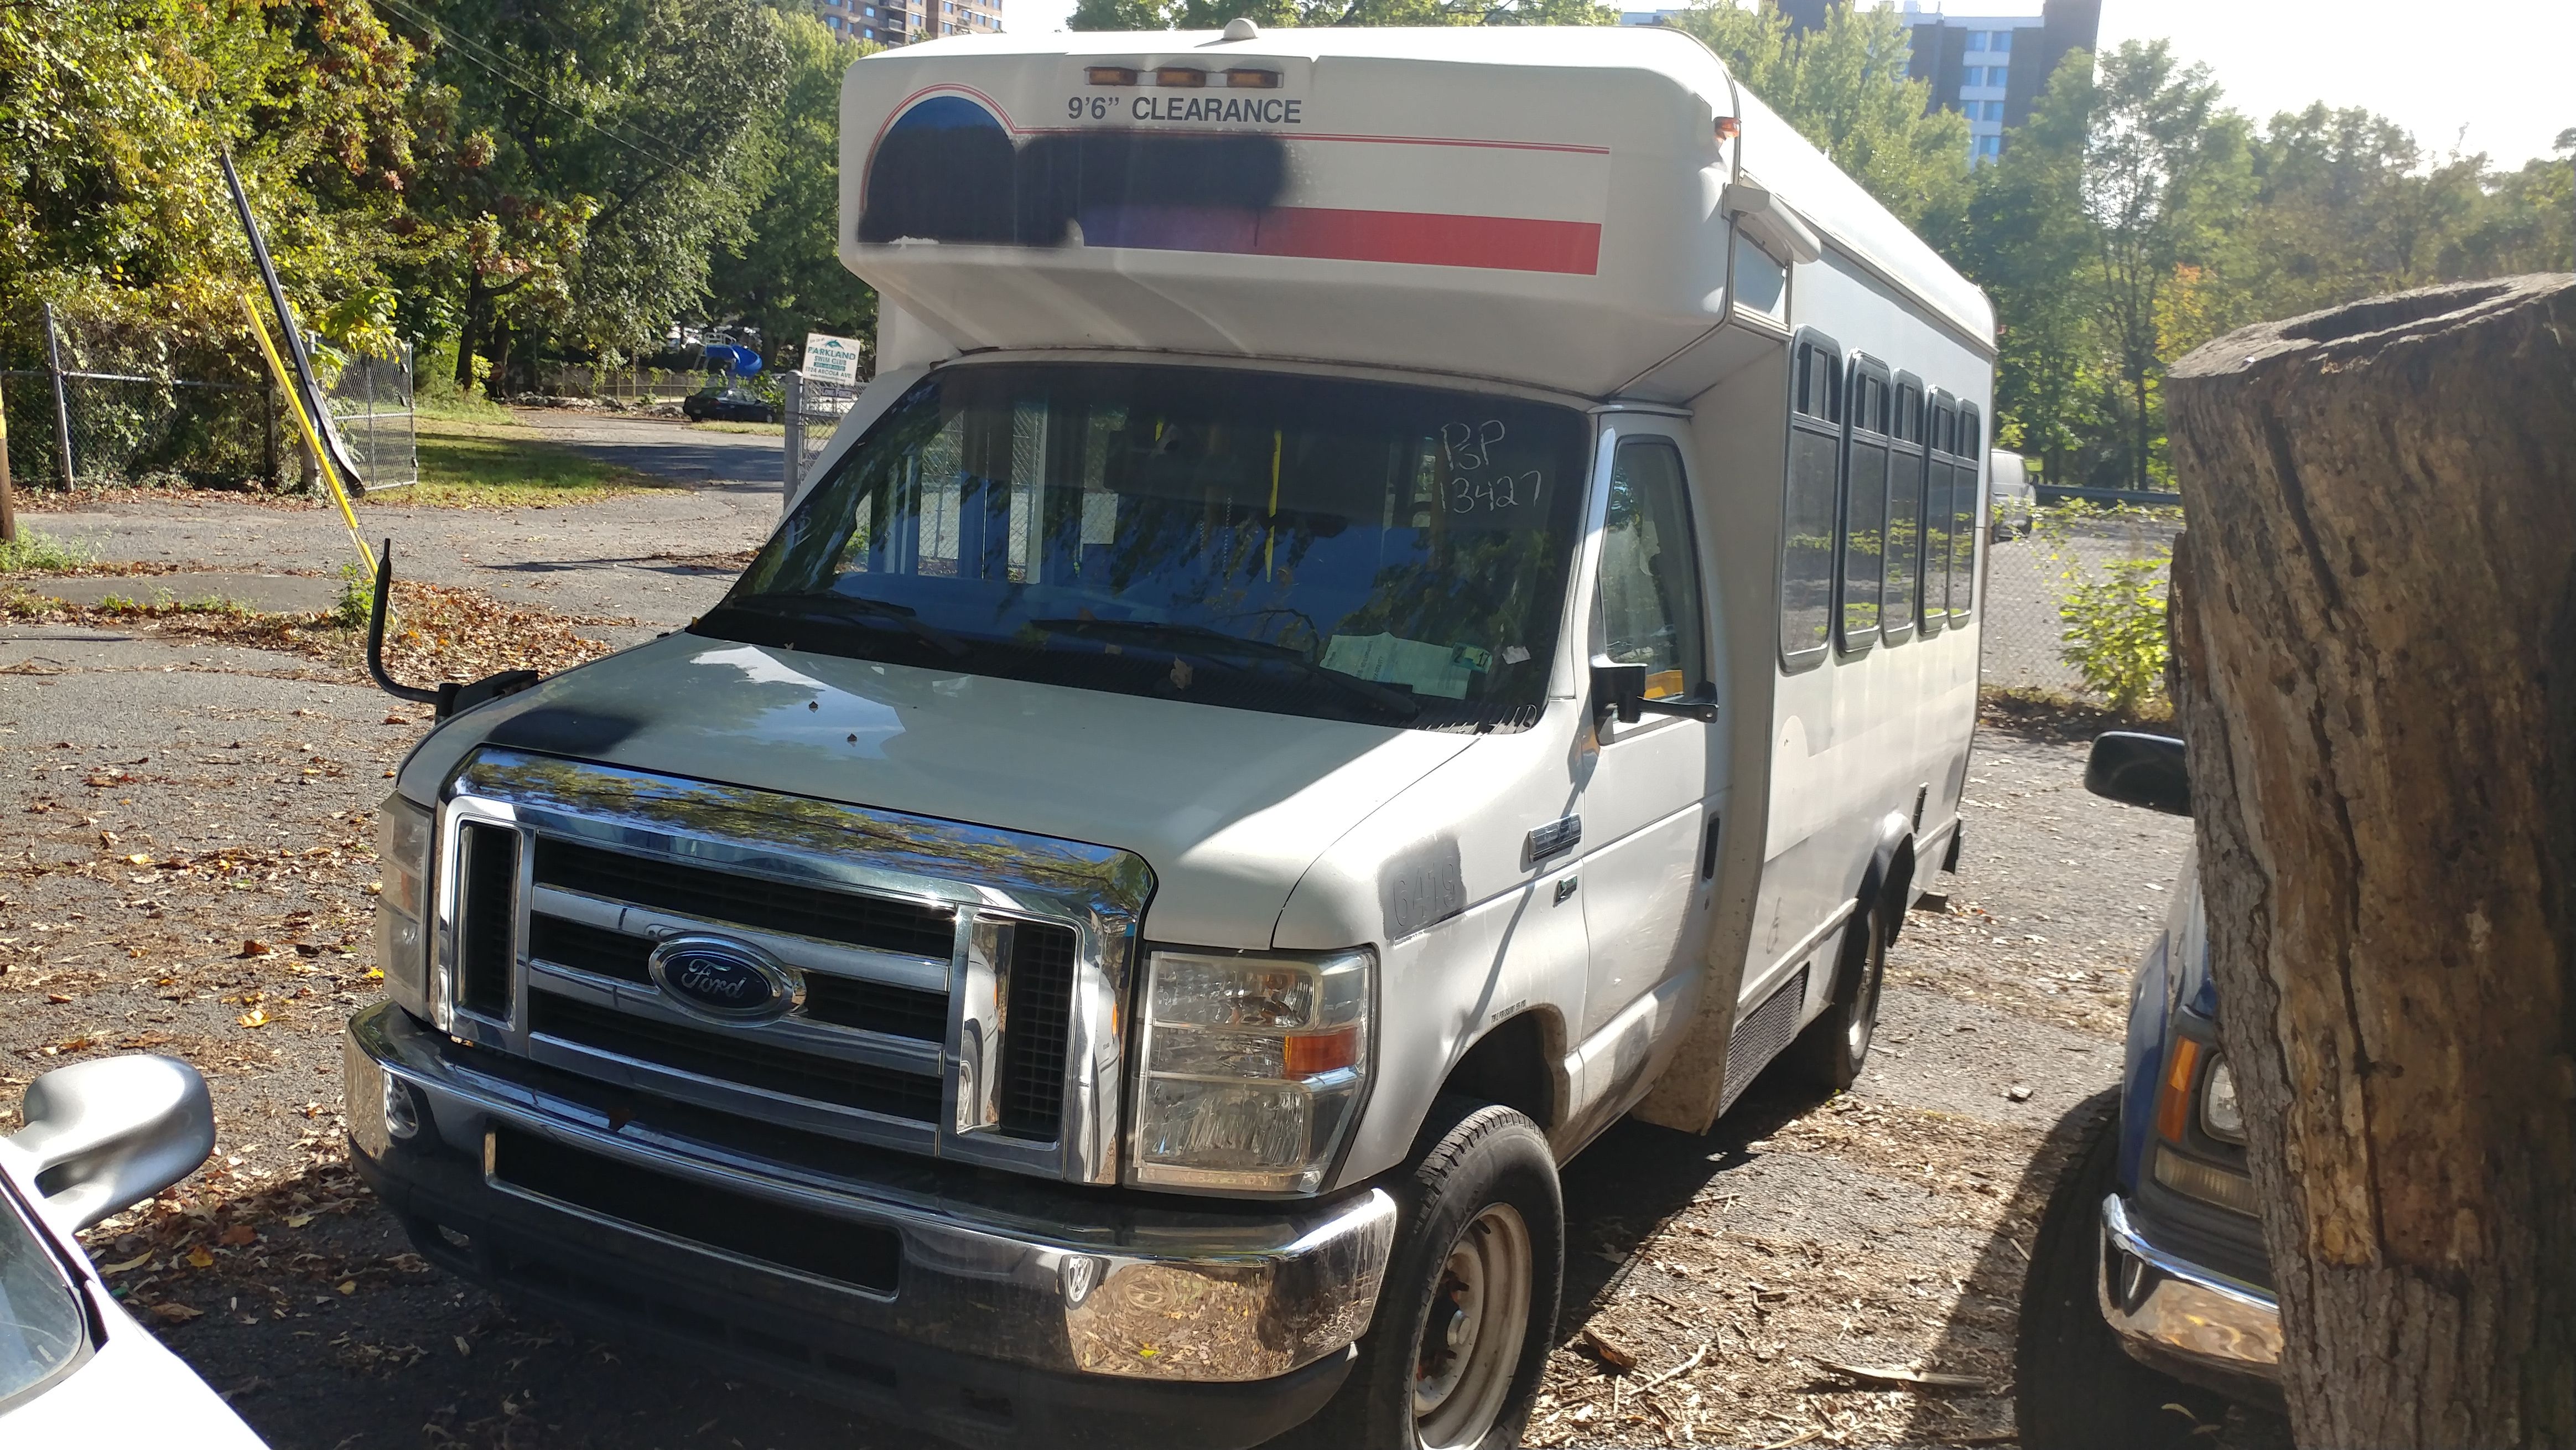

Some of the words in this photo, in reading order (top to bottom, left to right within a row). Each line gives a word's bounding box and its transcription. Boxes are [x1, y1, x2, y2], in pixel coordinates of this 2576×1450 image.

[1132, 97, 1301, 124] CLEARANCE
[808, 346, 856, 360] PARKLAND
[1440, 470, 1541, 514] 13427
[681, 959, 747, 998] Ford
